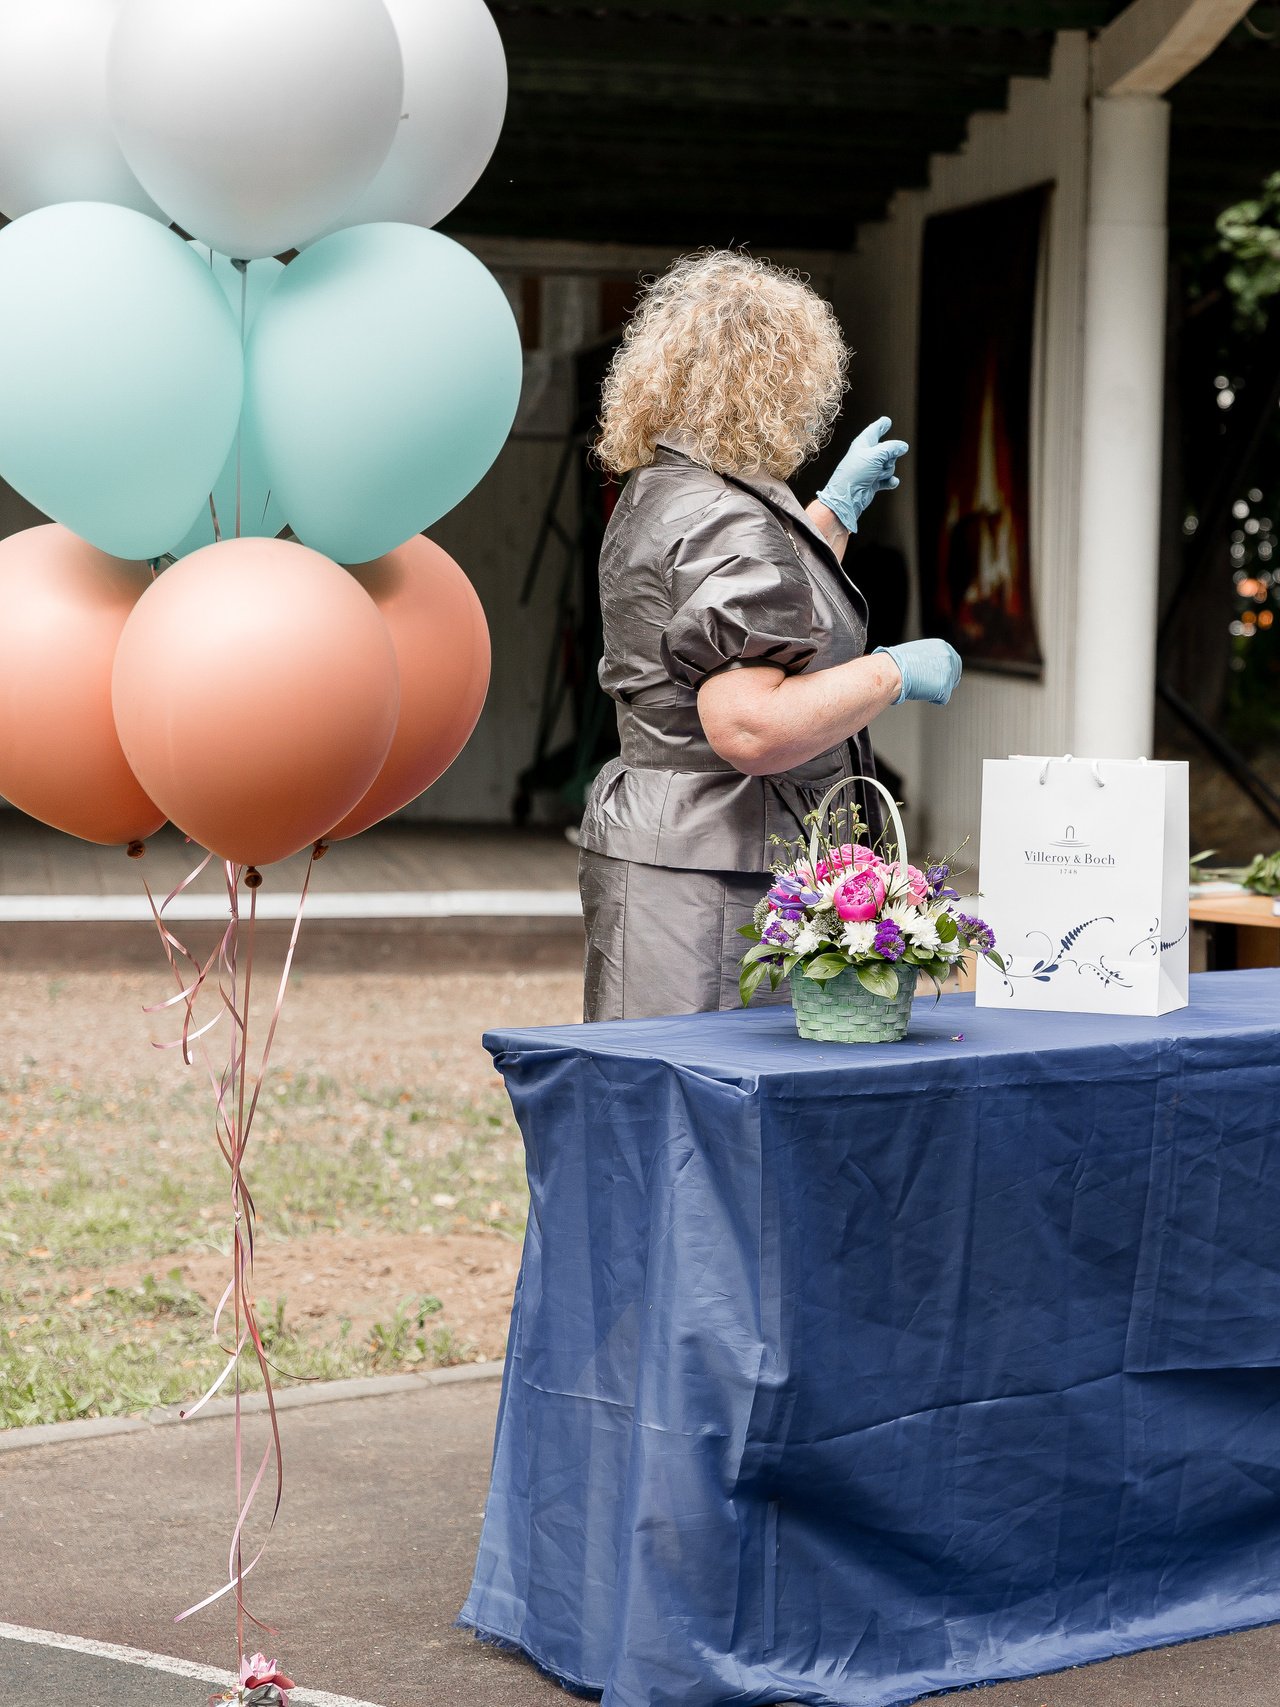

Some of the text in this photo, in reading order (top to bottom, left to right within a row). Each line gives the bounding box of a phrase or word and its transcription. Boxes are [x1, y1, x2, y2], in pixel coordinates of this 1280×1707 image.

[1024, 850, 1115, 866] Villeroy & Boch
